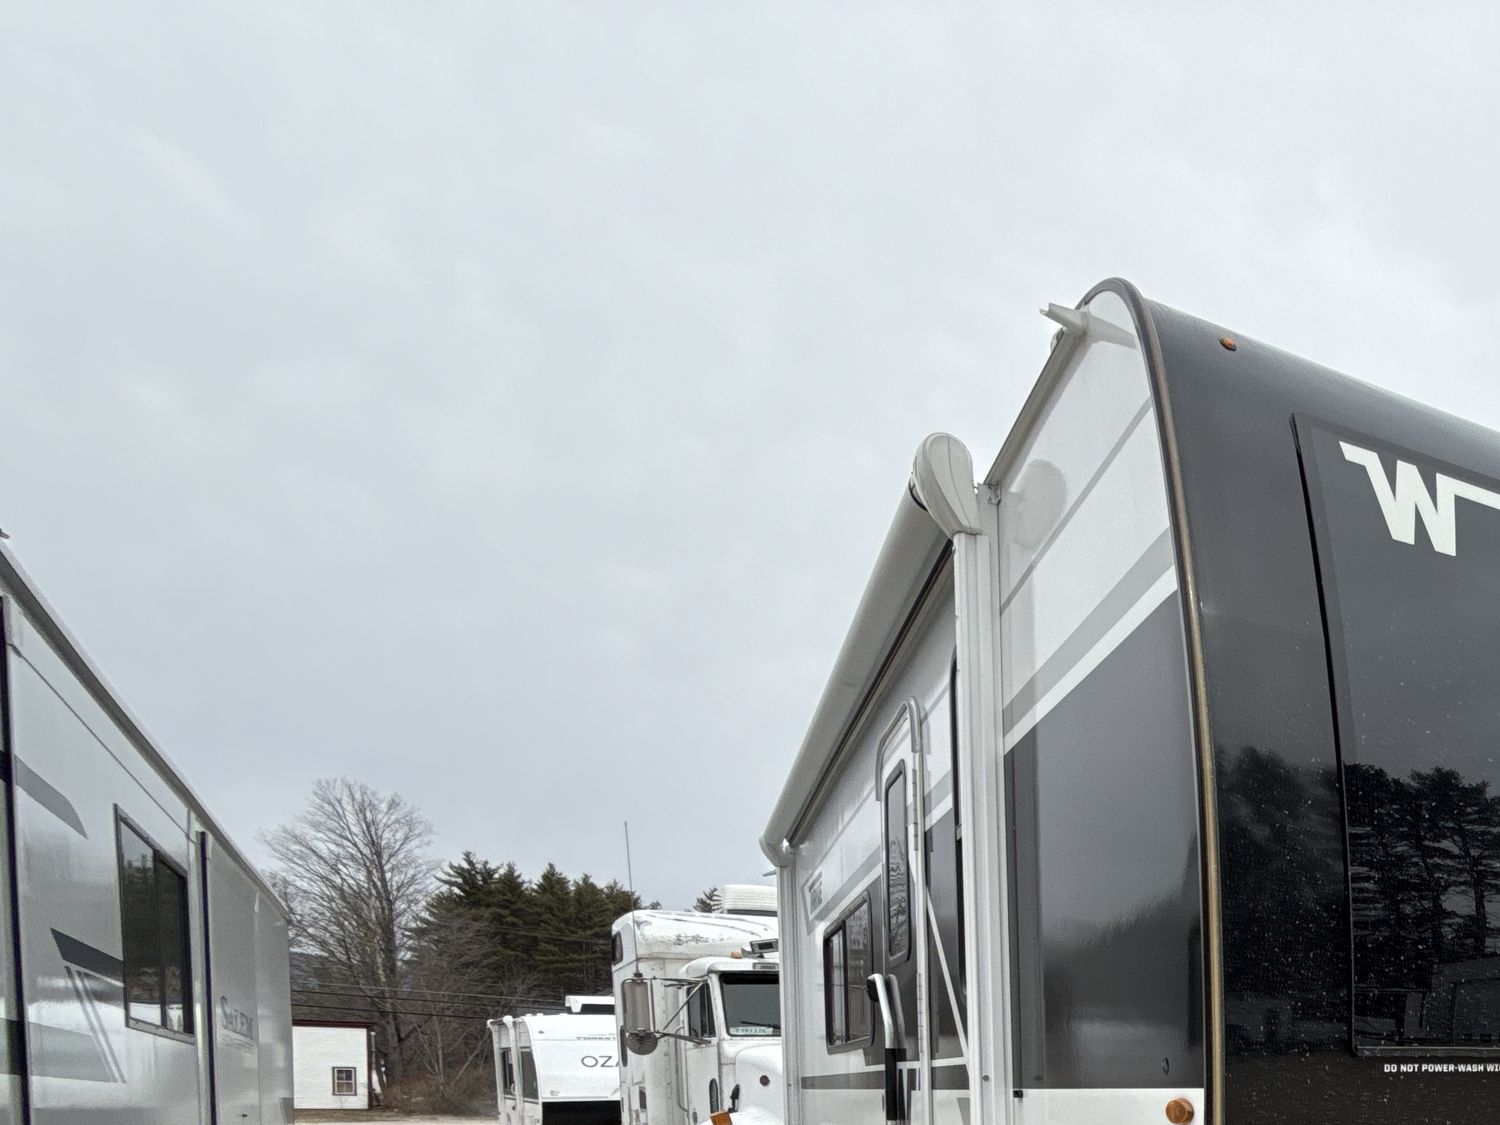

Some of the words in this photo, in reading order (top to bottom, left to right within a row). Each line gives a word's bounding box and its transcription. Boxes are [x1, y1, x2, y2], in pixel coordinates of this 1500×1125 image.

[1384, 1064, 1397, 1073] DO
[1400, 1064, 1419, 1073] NOT
[1421, 1063, 1484, 1073] POWER-WASH
